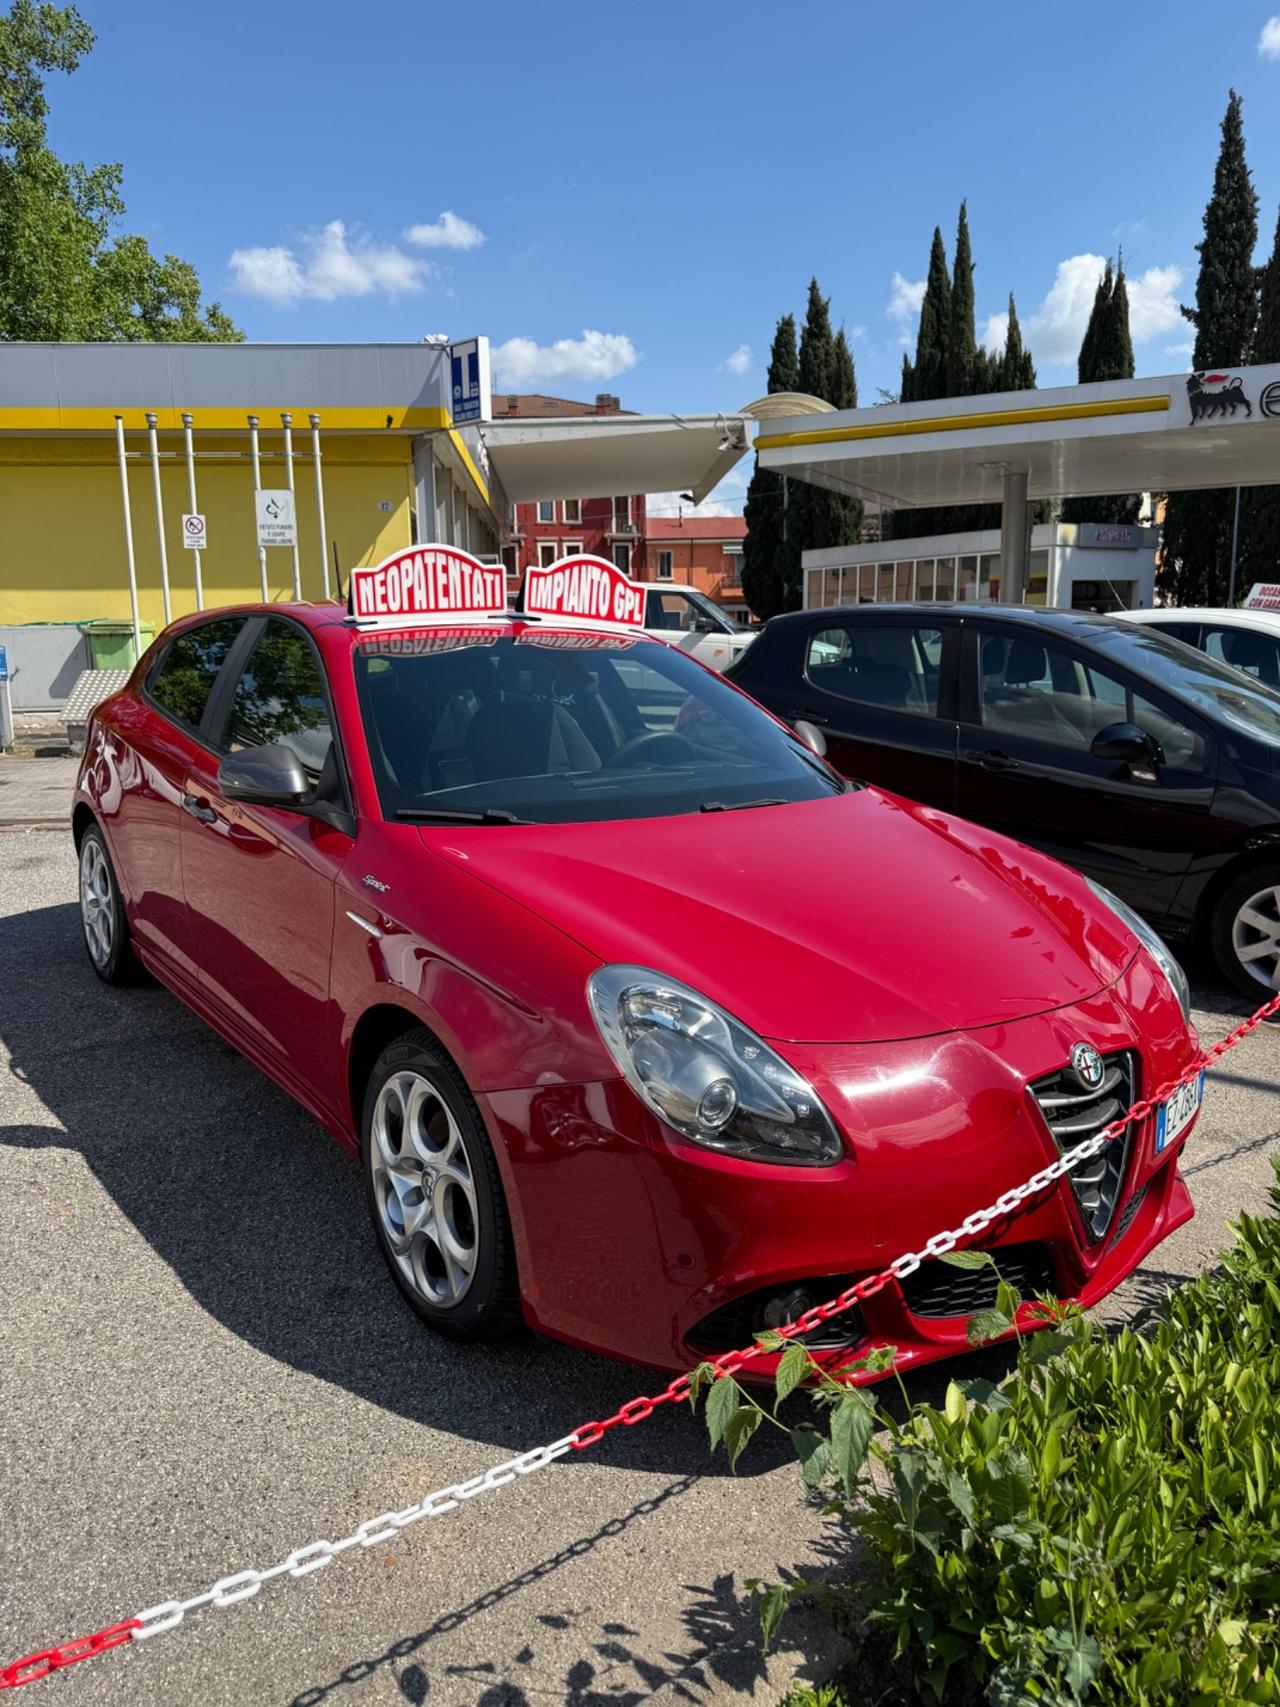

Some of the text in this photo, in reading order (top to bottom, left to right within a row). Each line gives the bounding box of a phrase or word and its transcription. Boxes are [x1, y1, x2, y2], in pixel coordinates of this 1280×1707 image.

[452, 340, 477, 399] T
[360, 552, 501, 613] NEOPATENTATI
[530, 565, 642, 622] IMPIANTO GPL
